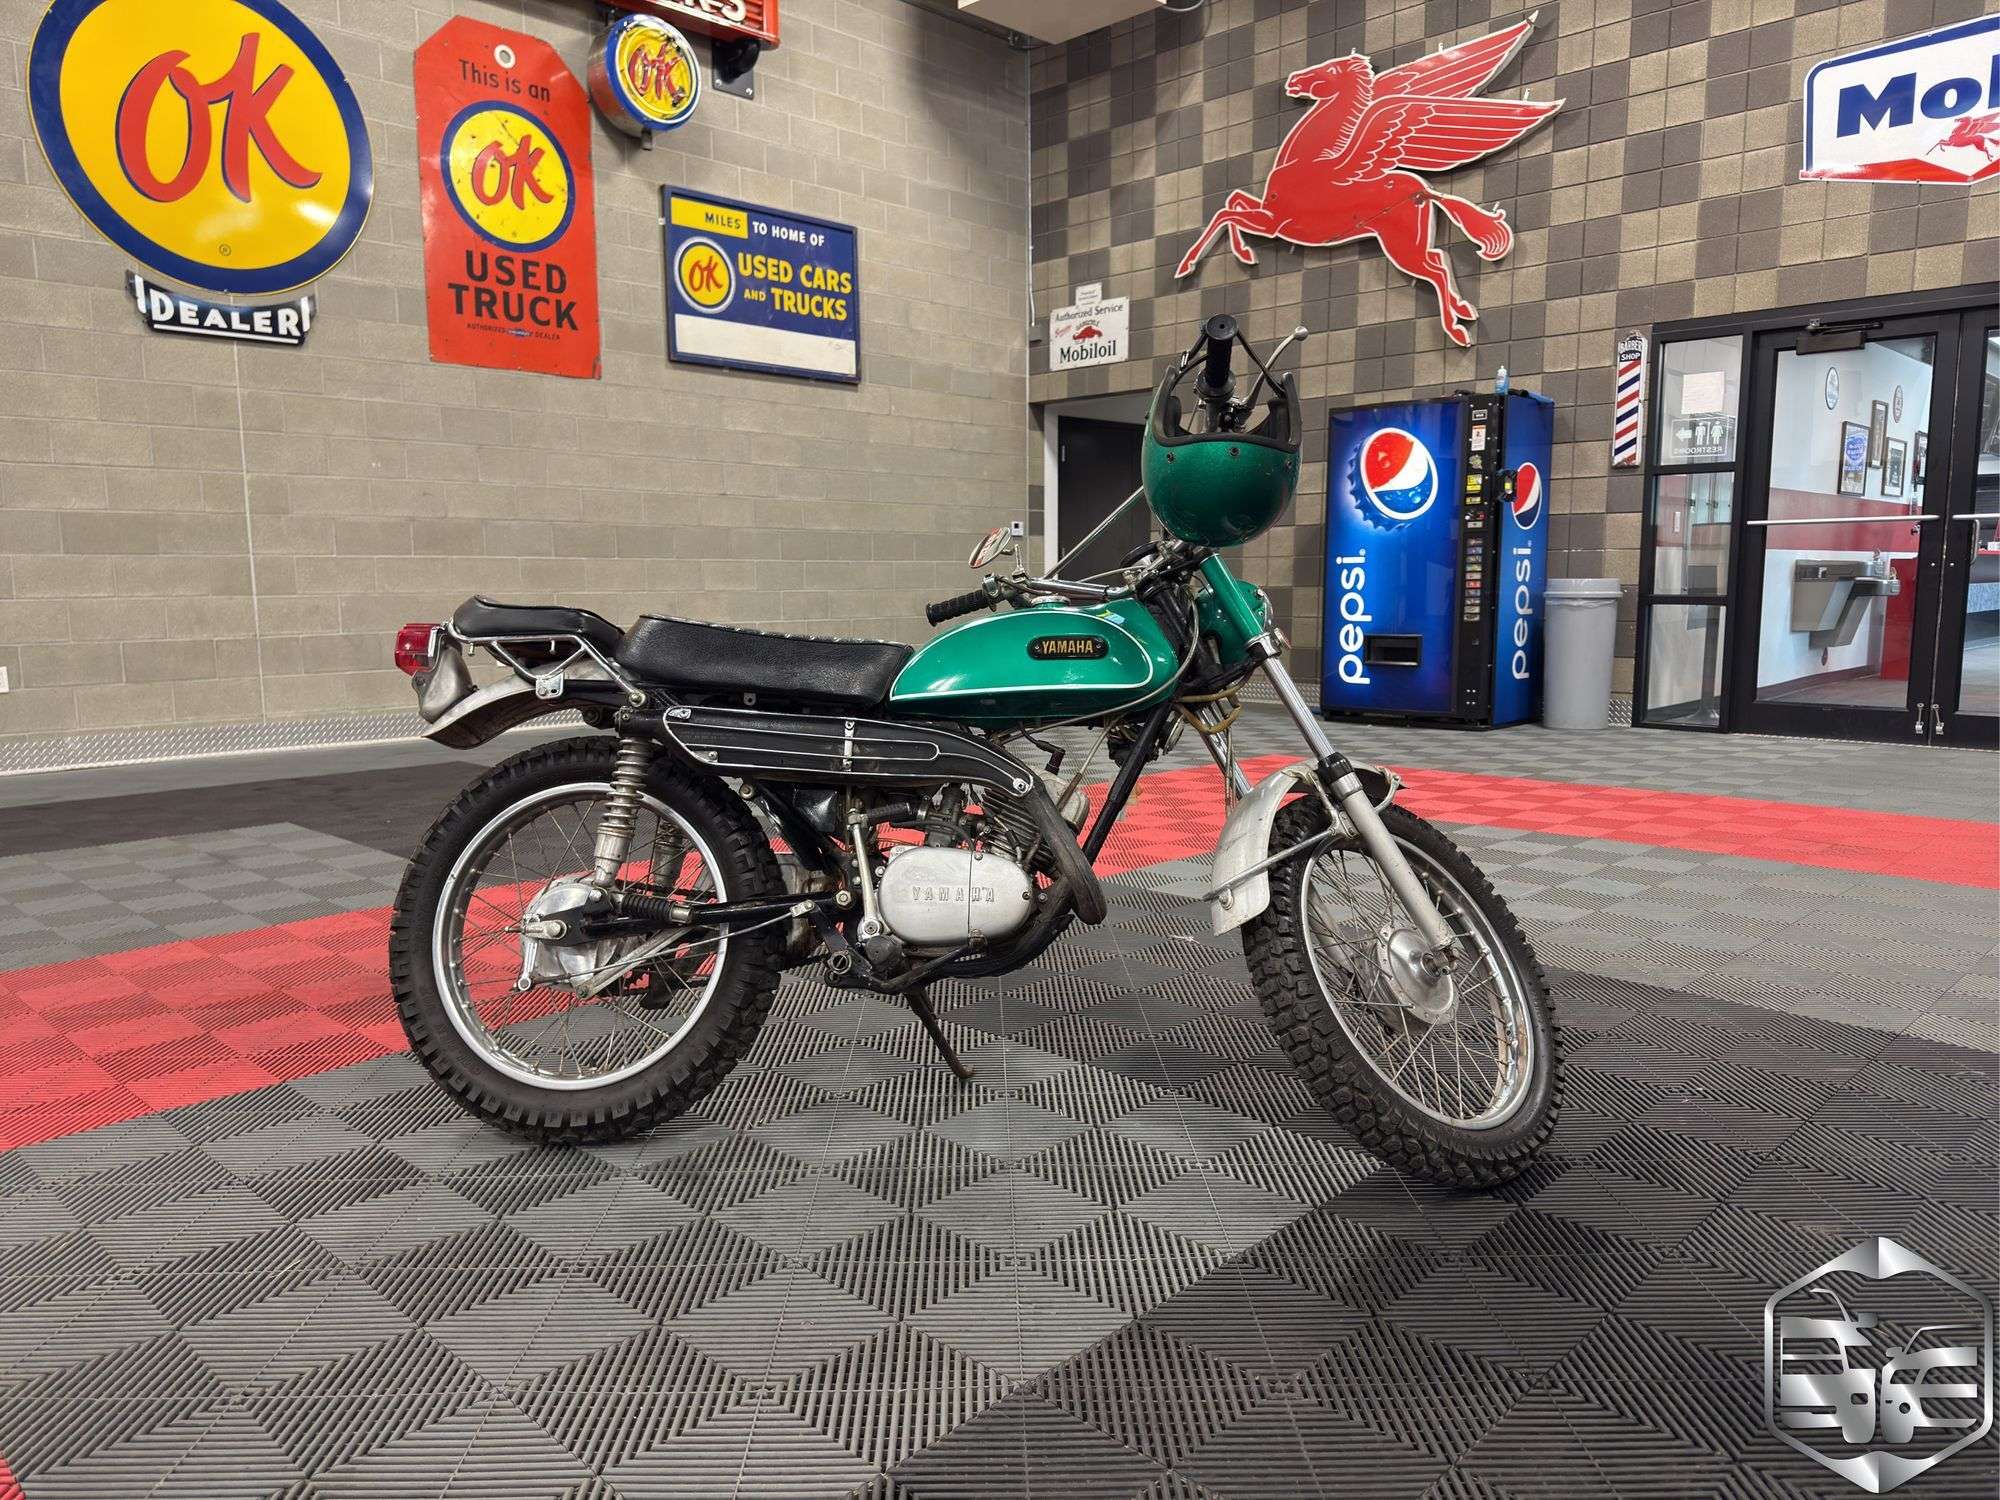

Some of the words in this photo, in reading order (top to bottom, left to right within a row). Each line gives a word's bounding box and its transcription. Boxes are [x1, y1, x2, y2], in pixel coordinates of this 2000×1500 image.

[459, 59, 499, 88] This
[505, 71, 521, 94] is
[528, 84, 550, 102] an
[628, 42, 686, 107] OK
[115, 32, 323, 203] OK
[471, 134, 554, 210] OK
[705, 212, 741, 230] MILES
[752, 221, 768, 235] TO
[771, 226, 806, 243] HOME
[809, 233, 825, 247] OF
[465, 249, 567, 294] USED
[689, 256, 723, 292] OK
[737, 252, 793, 284] USED
[799, 264, 853, 295] CARS
[149, 288, 300, 336] DEALER
[448, 283, 578, 330] TRUCK
[743, 288, 767, 302] AND
[770, 287, 848, 322] TRUCKS
[1056, 307, 1093, 321] Authorized
[1094, 304, 1124, 315] Service
[1060, 339, 1117, 363] Mobiloil
[1621, 353, 1640, 361] SHOP
[1336, 556, 1373, 685] pepsi
[1512, 547, 1533, 680] pepsi
[1042, 640, 1094, 655] YAMAHA
[911, 886, 995, 903] YAMAHA
